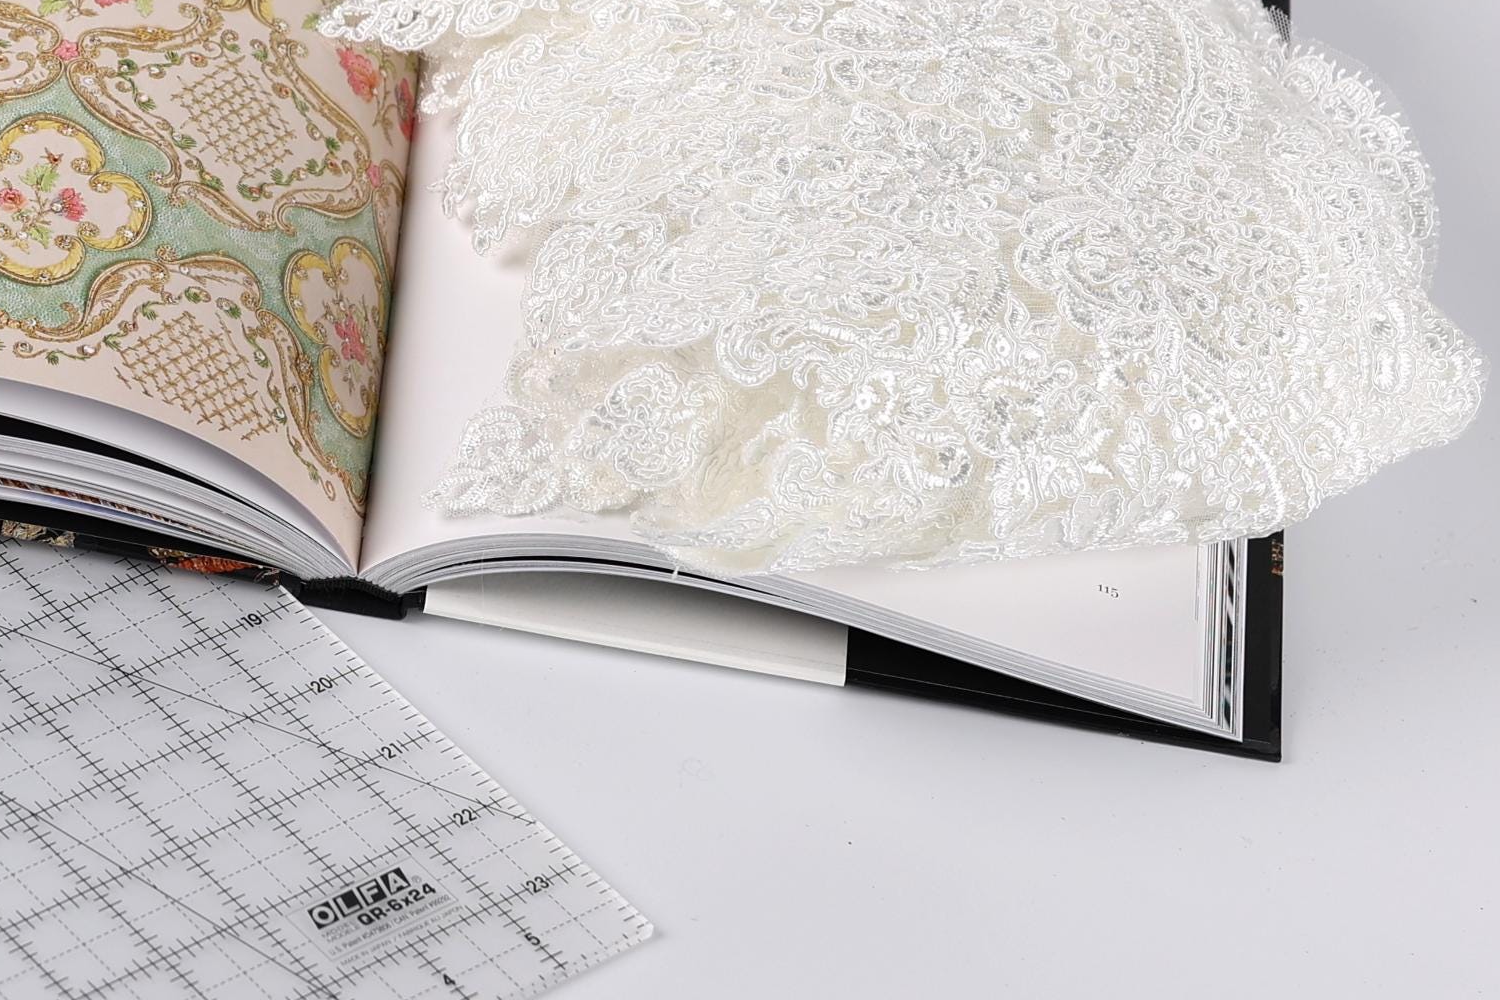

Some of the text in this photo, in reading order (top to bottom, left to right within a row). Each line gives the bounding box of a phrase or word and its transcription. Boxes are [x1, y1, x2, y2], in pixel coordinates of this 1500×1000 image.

[1097, 584, 1119, 599] 115
[241, 613, 262, 627] 19
[310, 677, 333, 693] 20
[381, 743, 403, 759] 21
[453, 808, 477, 825] 22
[526, 876, 549, 893] 23
[307, 867, 411, 930] OLFA
[357, 883, 436, 926] QR-6x24
[524, 932, 540, 946] 5
[442, 974, 456, 986] 4
